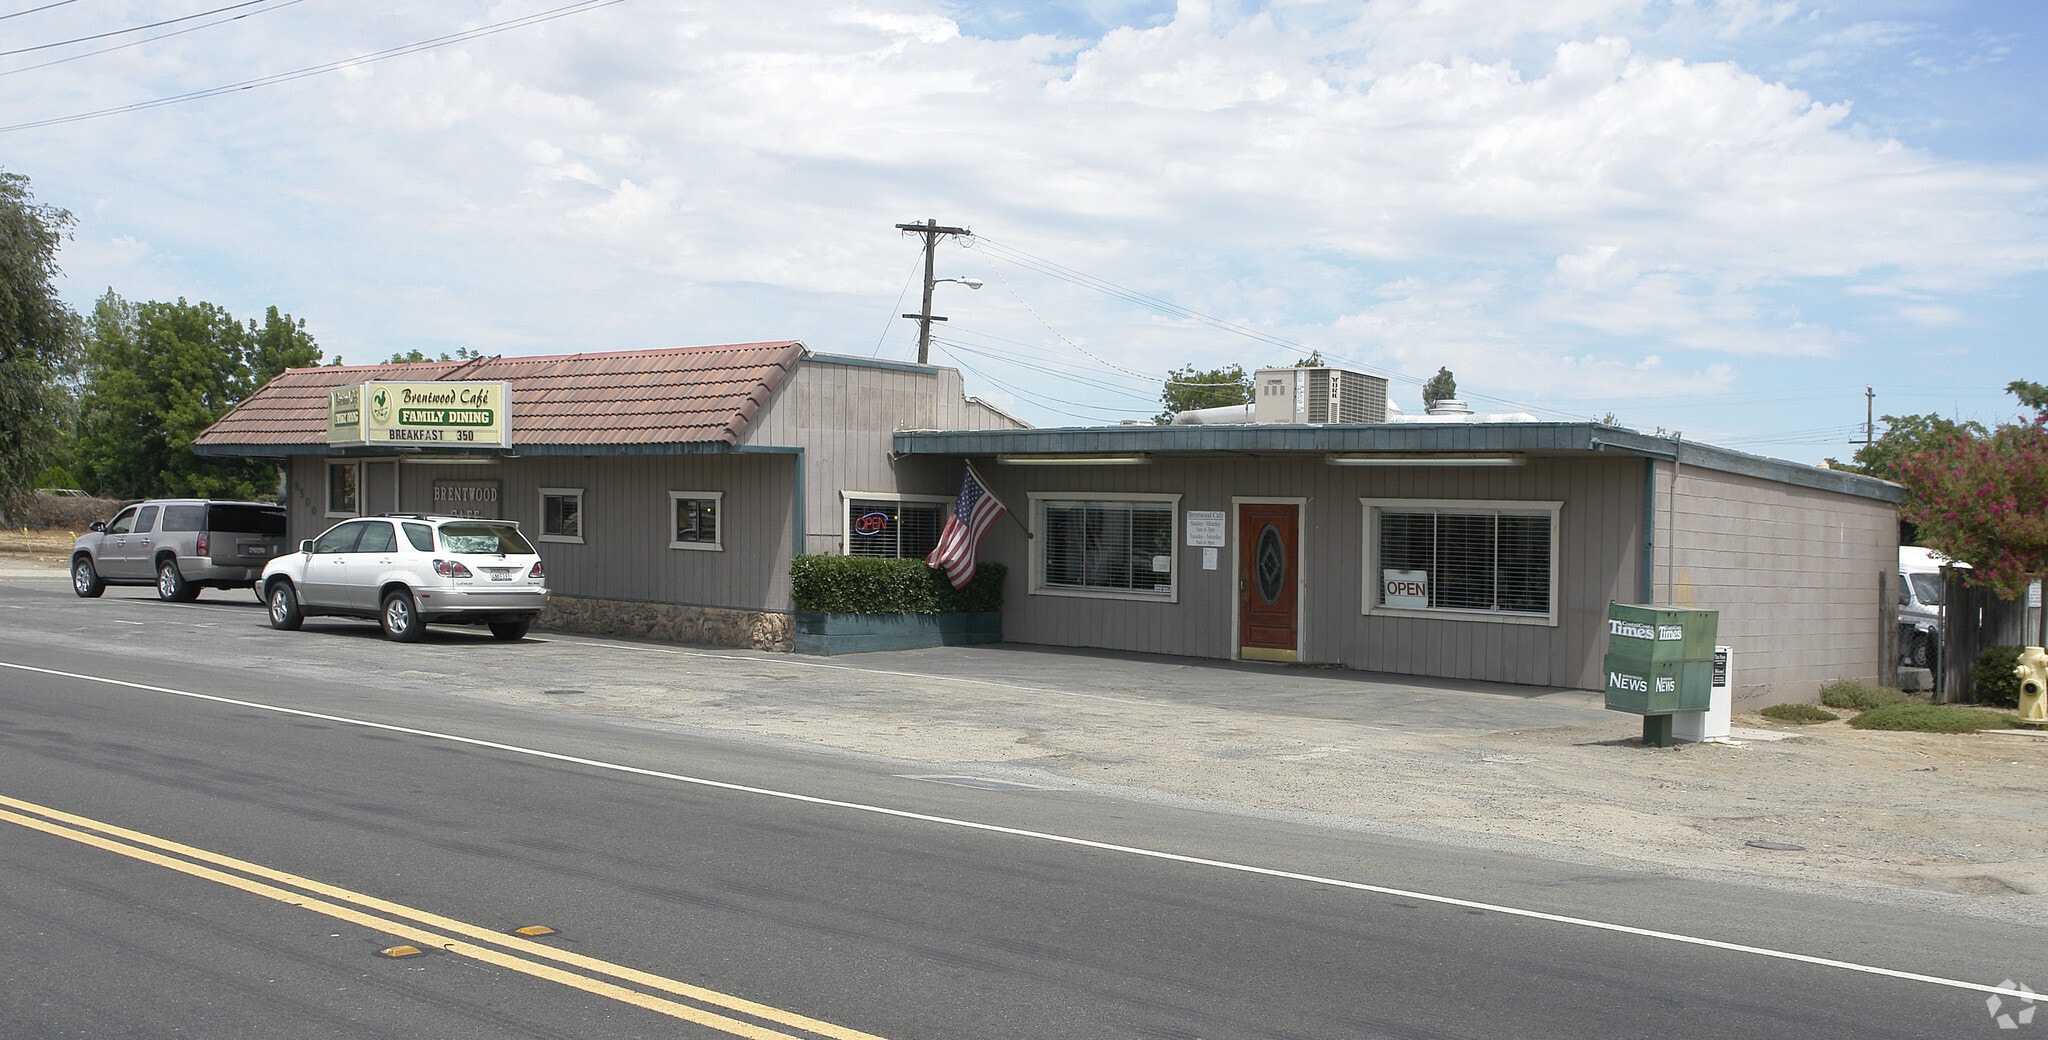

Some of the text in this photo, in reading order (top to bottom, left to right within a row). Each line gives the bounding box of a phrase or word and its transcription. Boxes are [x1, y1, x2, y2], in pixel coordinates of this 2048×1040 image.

[401, 388, 489, 408] Brentwood Café
[402, 410, 445, 423] FAMILY
[448, 411, 490, 424] DINING
[389, 429, 474, 441] BREAKFAST 350
[434, 486, 497, 502] BRENTWOOD
[855, 516, 887, 531] OPEN
[1387, 581, 1425, 596] OPEN
[1608, 619, 1655, 640] Times
[1658, 626, 1682, 640] Times
[1609, 671, 1648, 693] NEWS
